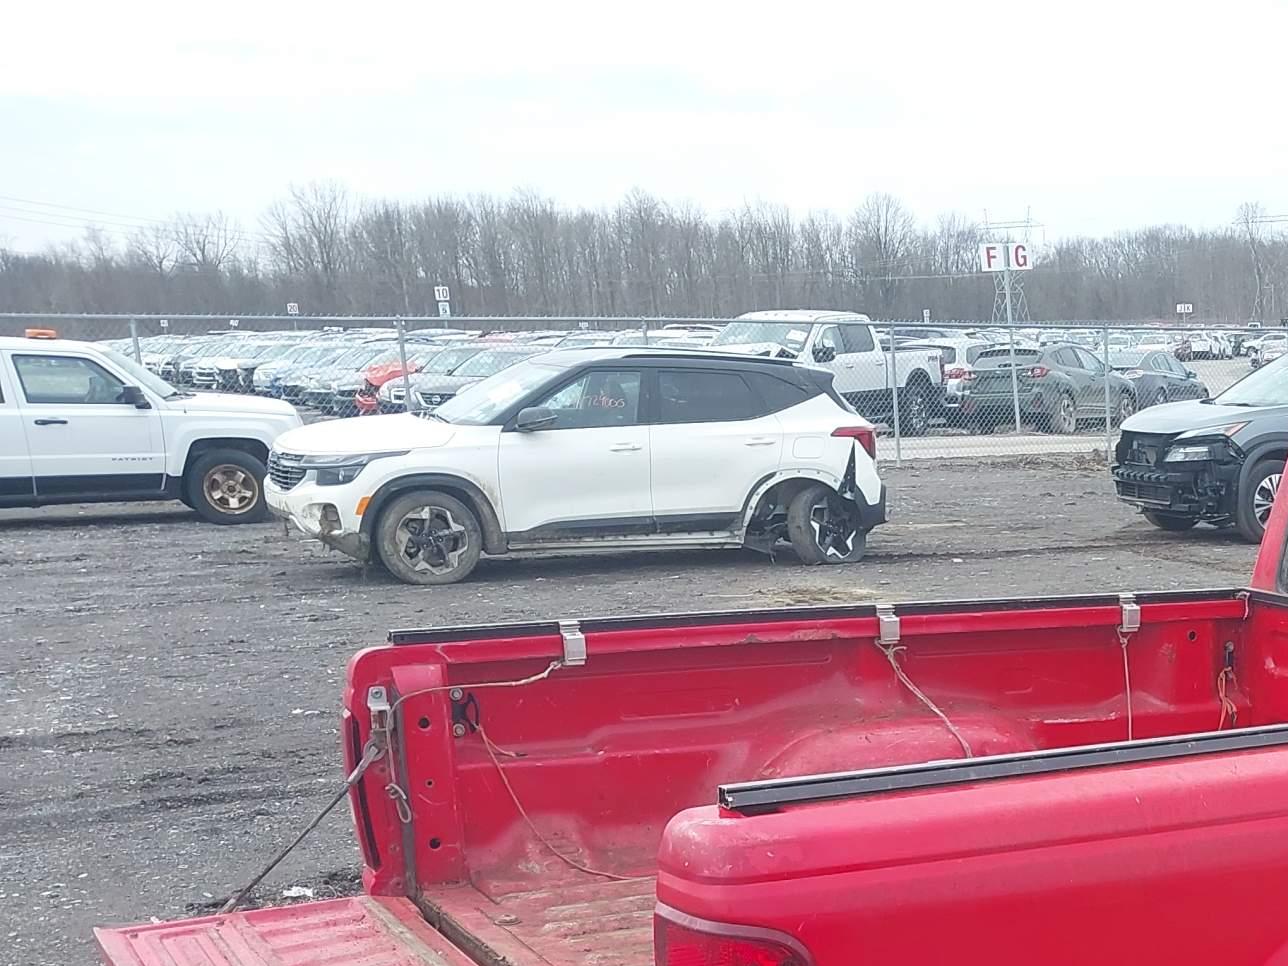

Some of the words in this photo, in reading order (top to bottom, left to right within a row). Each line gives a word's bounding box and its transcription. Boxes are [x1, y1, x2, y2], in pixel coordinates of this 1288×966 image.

[985, 246, 998, 269] F
[1014, 244, 1028, 268] G
[436, 287, 448, 299] 10
